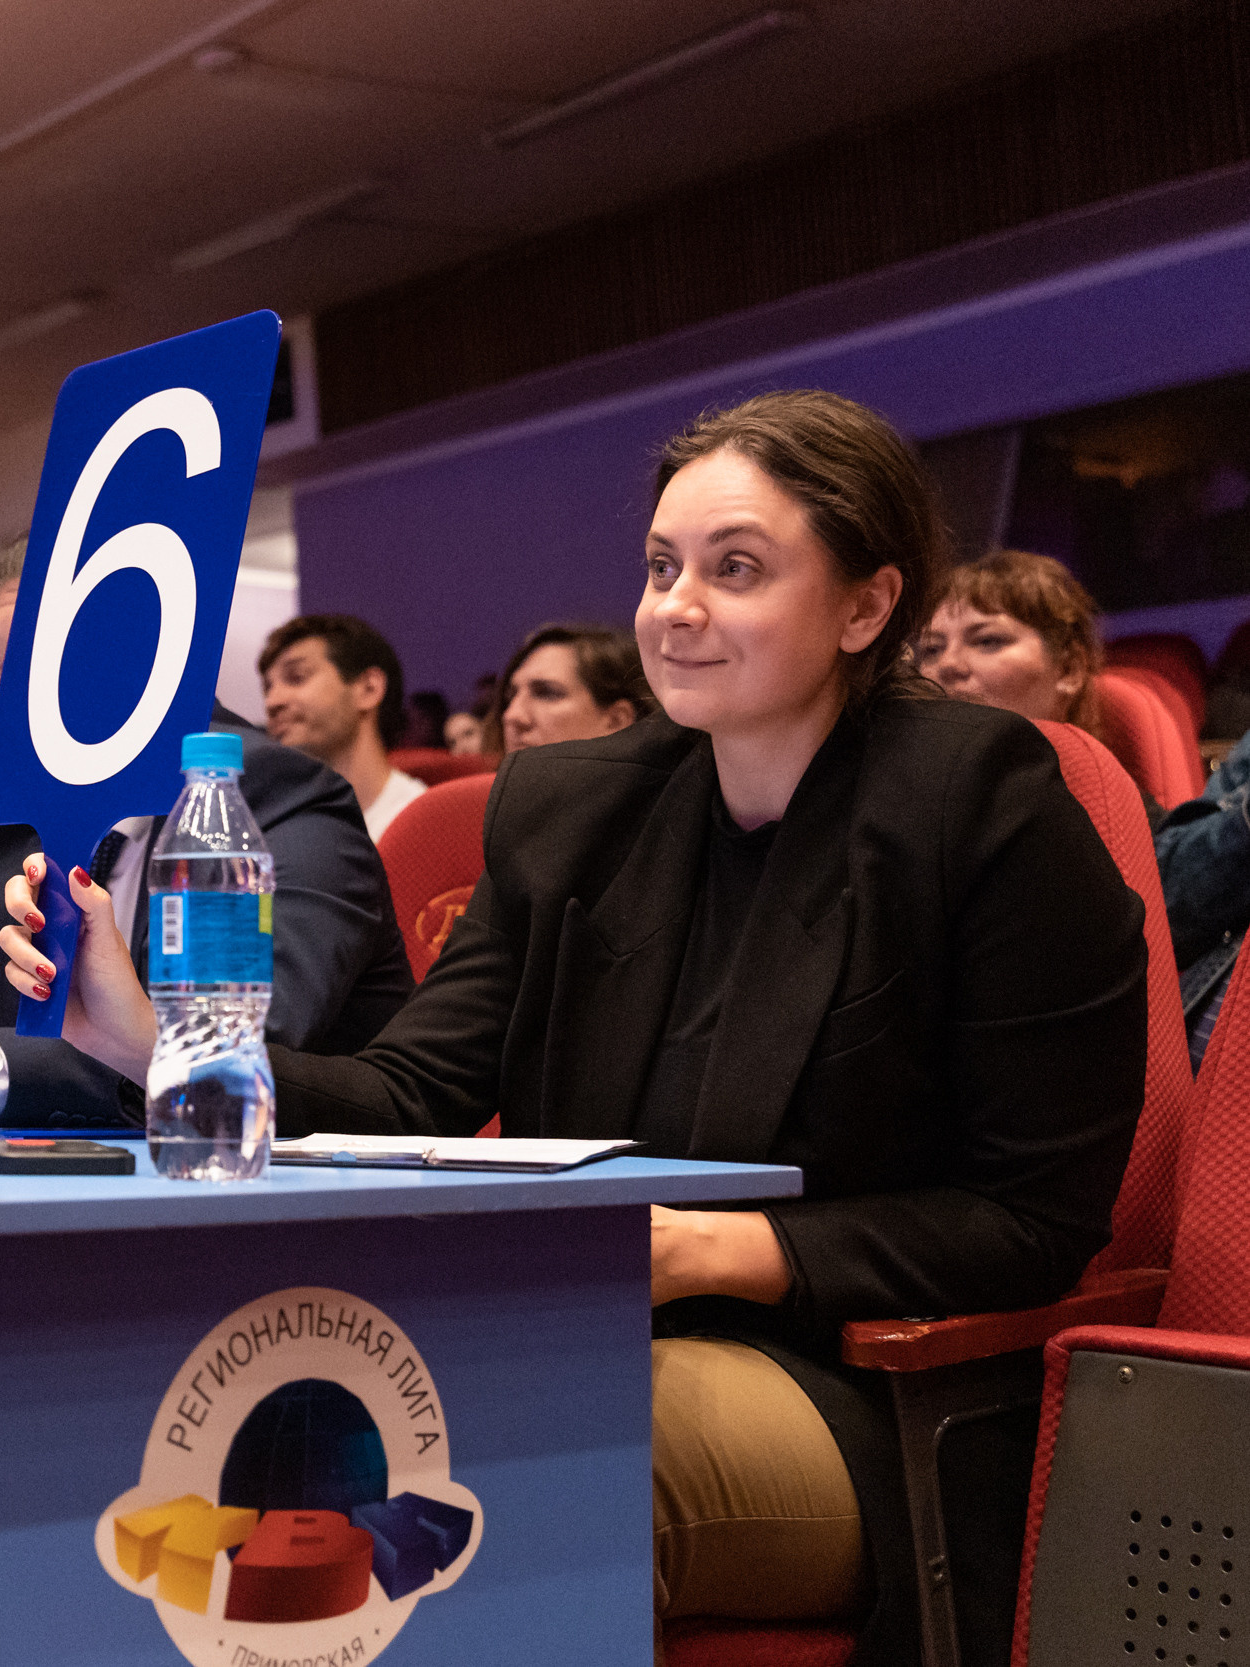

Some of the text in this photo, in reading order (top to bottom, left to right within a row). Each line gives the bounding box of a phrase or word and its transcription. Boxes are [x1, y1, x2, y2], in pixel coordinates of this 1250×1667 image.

[28, 387, 222, 786] 6
[166, 1302, 441, 1455] РЕГИОНАЛЬНАЯ ЛИГА
